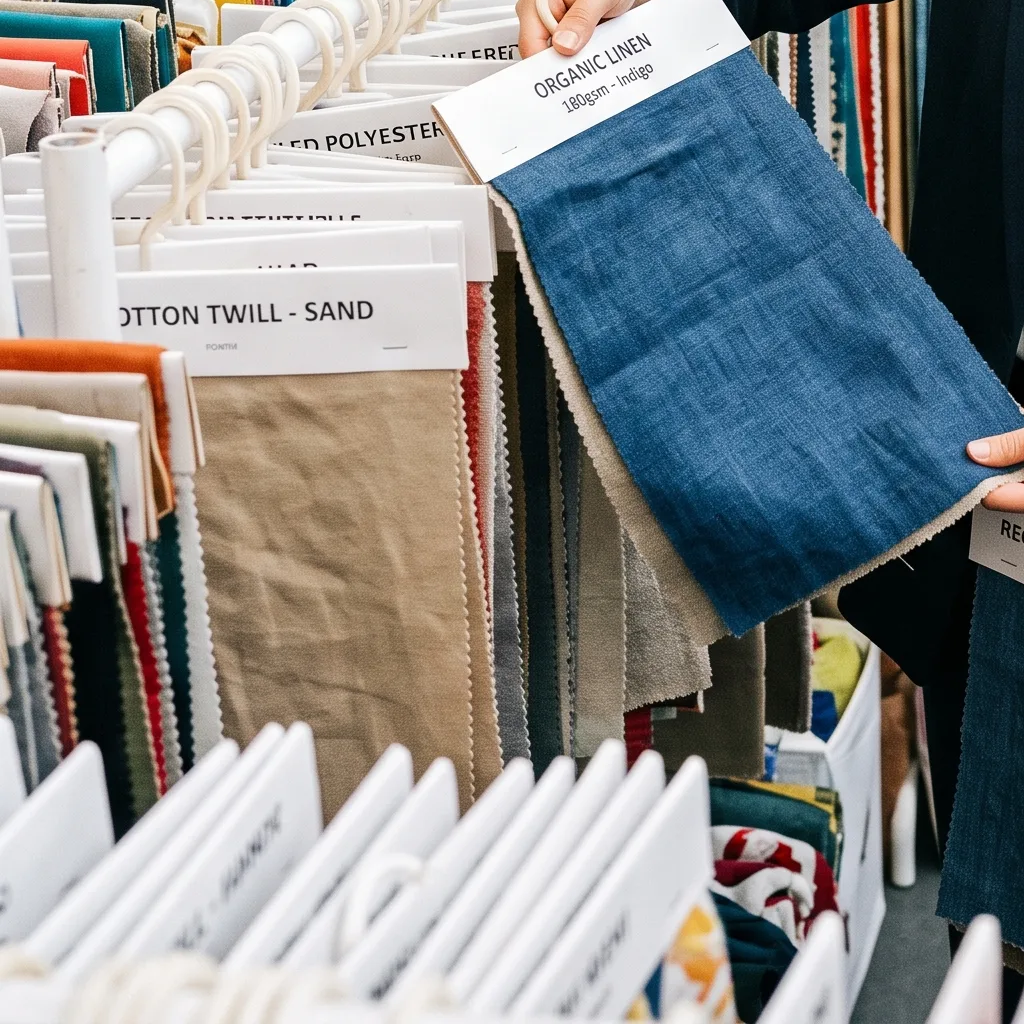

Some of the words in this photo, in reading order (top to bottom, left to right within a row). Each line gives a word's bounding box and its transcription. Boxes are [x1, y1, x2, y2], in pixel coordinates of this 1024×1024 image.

[534, 54, 607, 99] ORGANIC
[604, 32, 652, 65] LINEN
[562, 84, 610, 113] 180gsm
[615, 63, 654, 88] Indigo
[206, 303, 282, 324] TWILL
[304, 300, 374, 321] SAND
